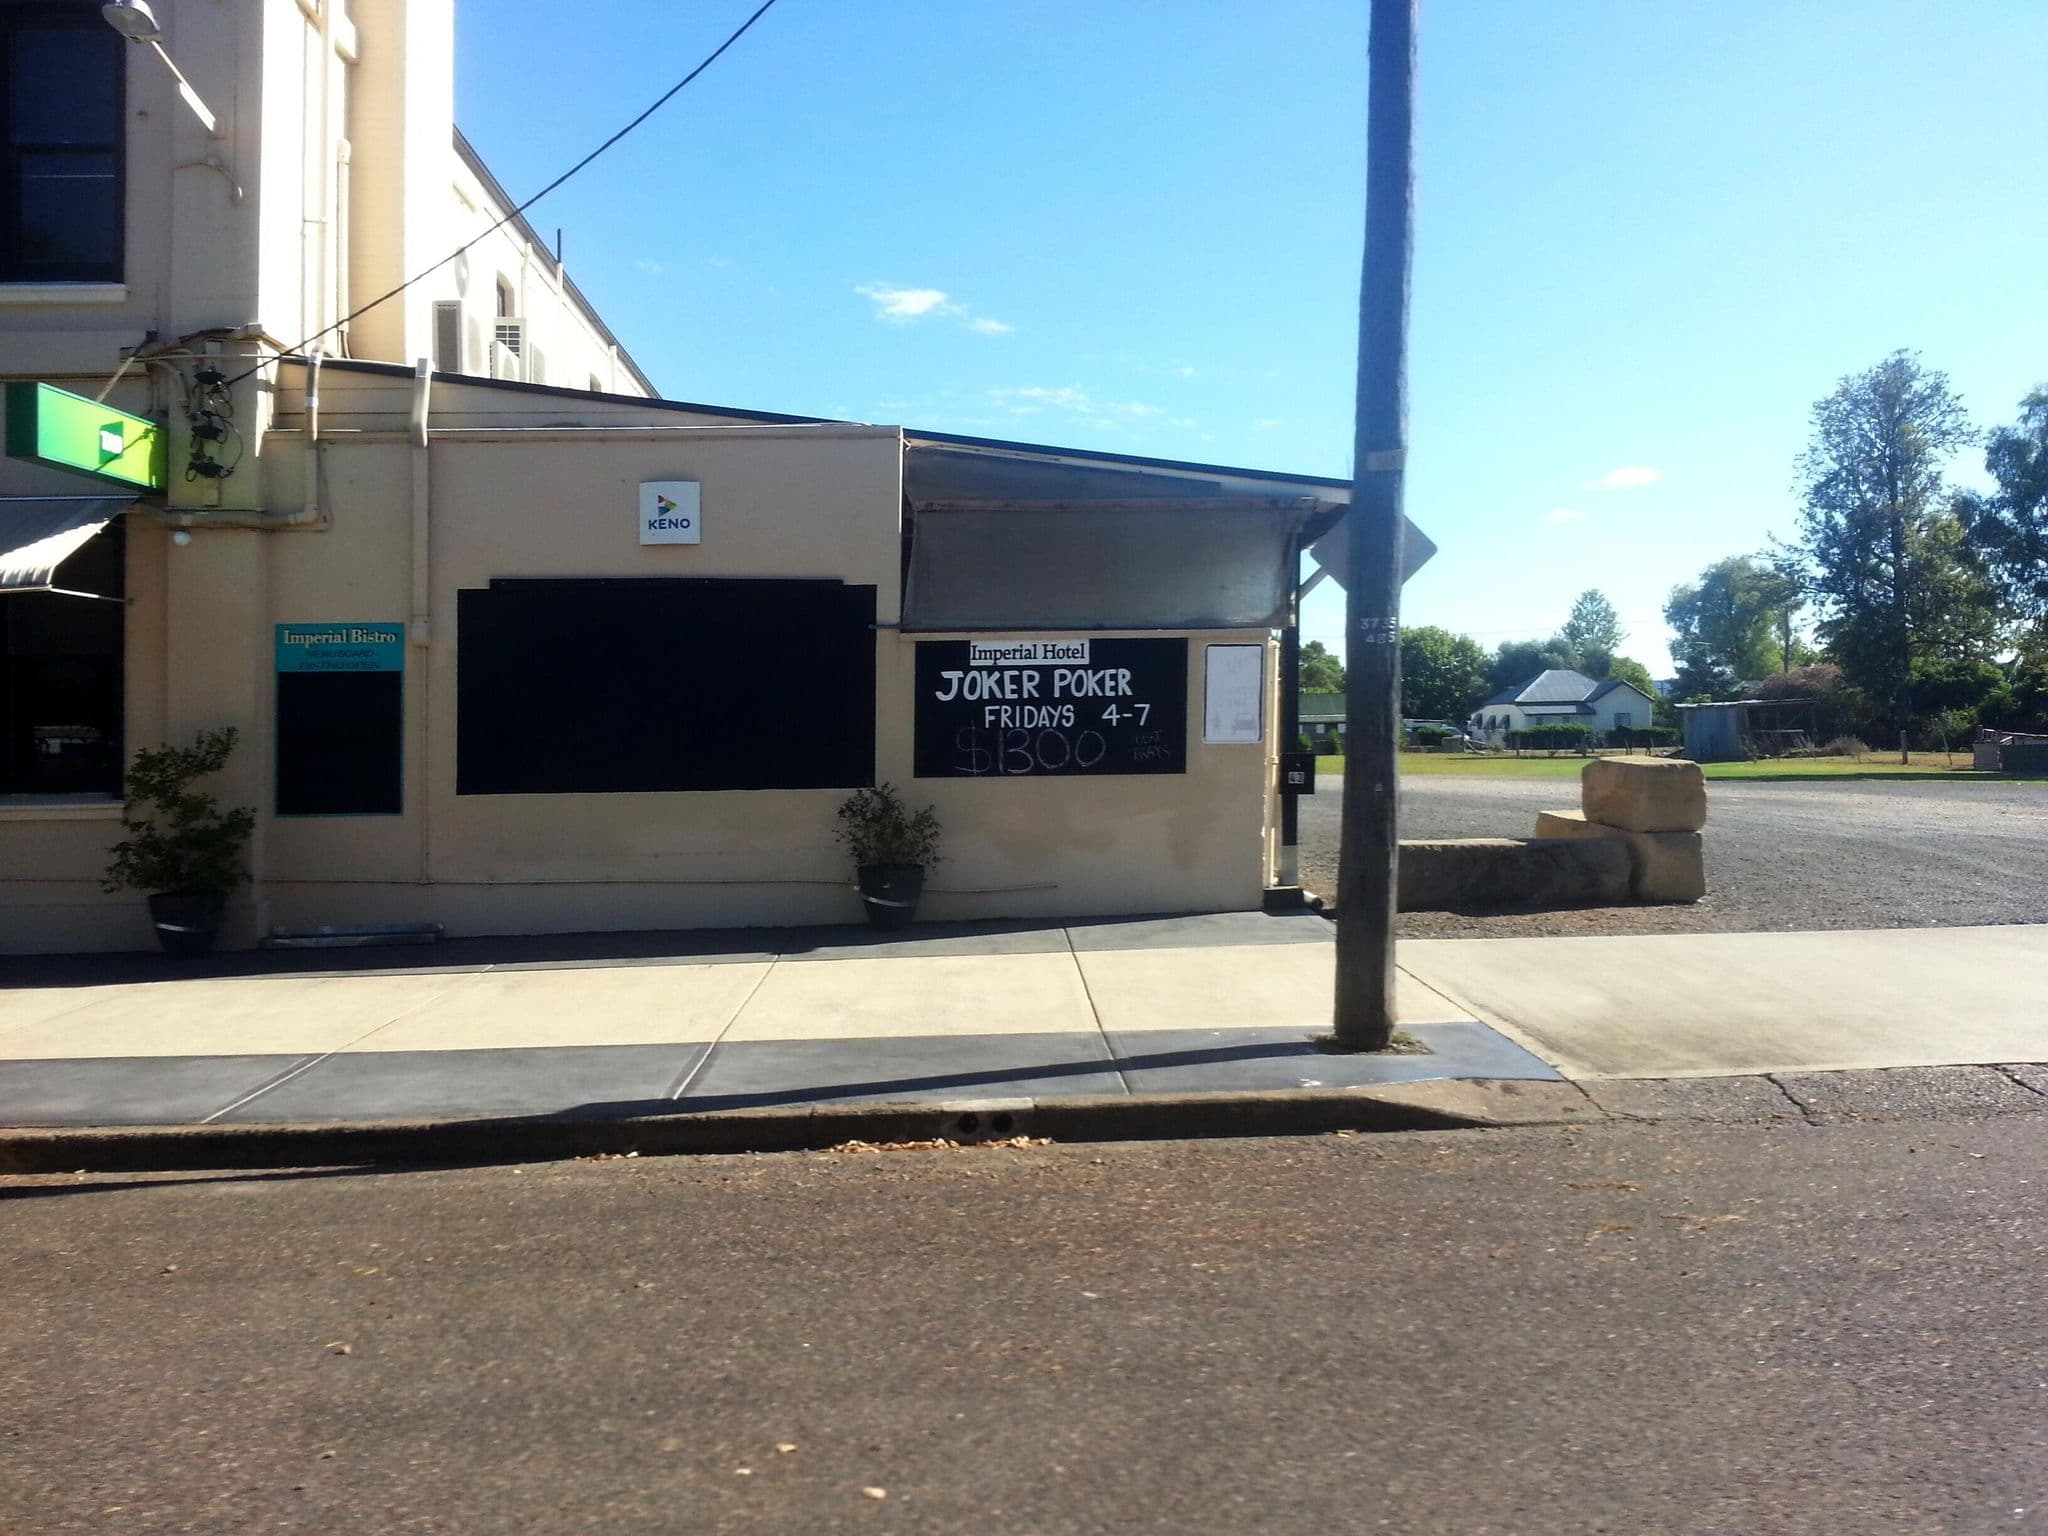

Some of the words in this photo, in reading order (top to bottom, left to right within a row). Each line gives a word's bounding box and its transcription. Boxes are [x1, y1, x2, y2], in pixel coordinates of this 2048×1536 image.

[648, 518, 691, 530] KENO
[283, 630, 346, 648] Imperial
[352, 629, 396, 644] Bistro
[971, 644, 1037, 665] Imperial
[1043, 643, 1085, 659] Hotel
[935, 670, 1040, 701] JOKER
[1053, 668, 1133, 697] POKER
[984, 705, 1075, 728] FRIDAYS
[1101, 704, 1150, 726] 4-7
